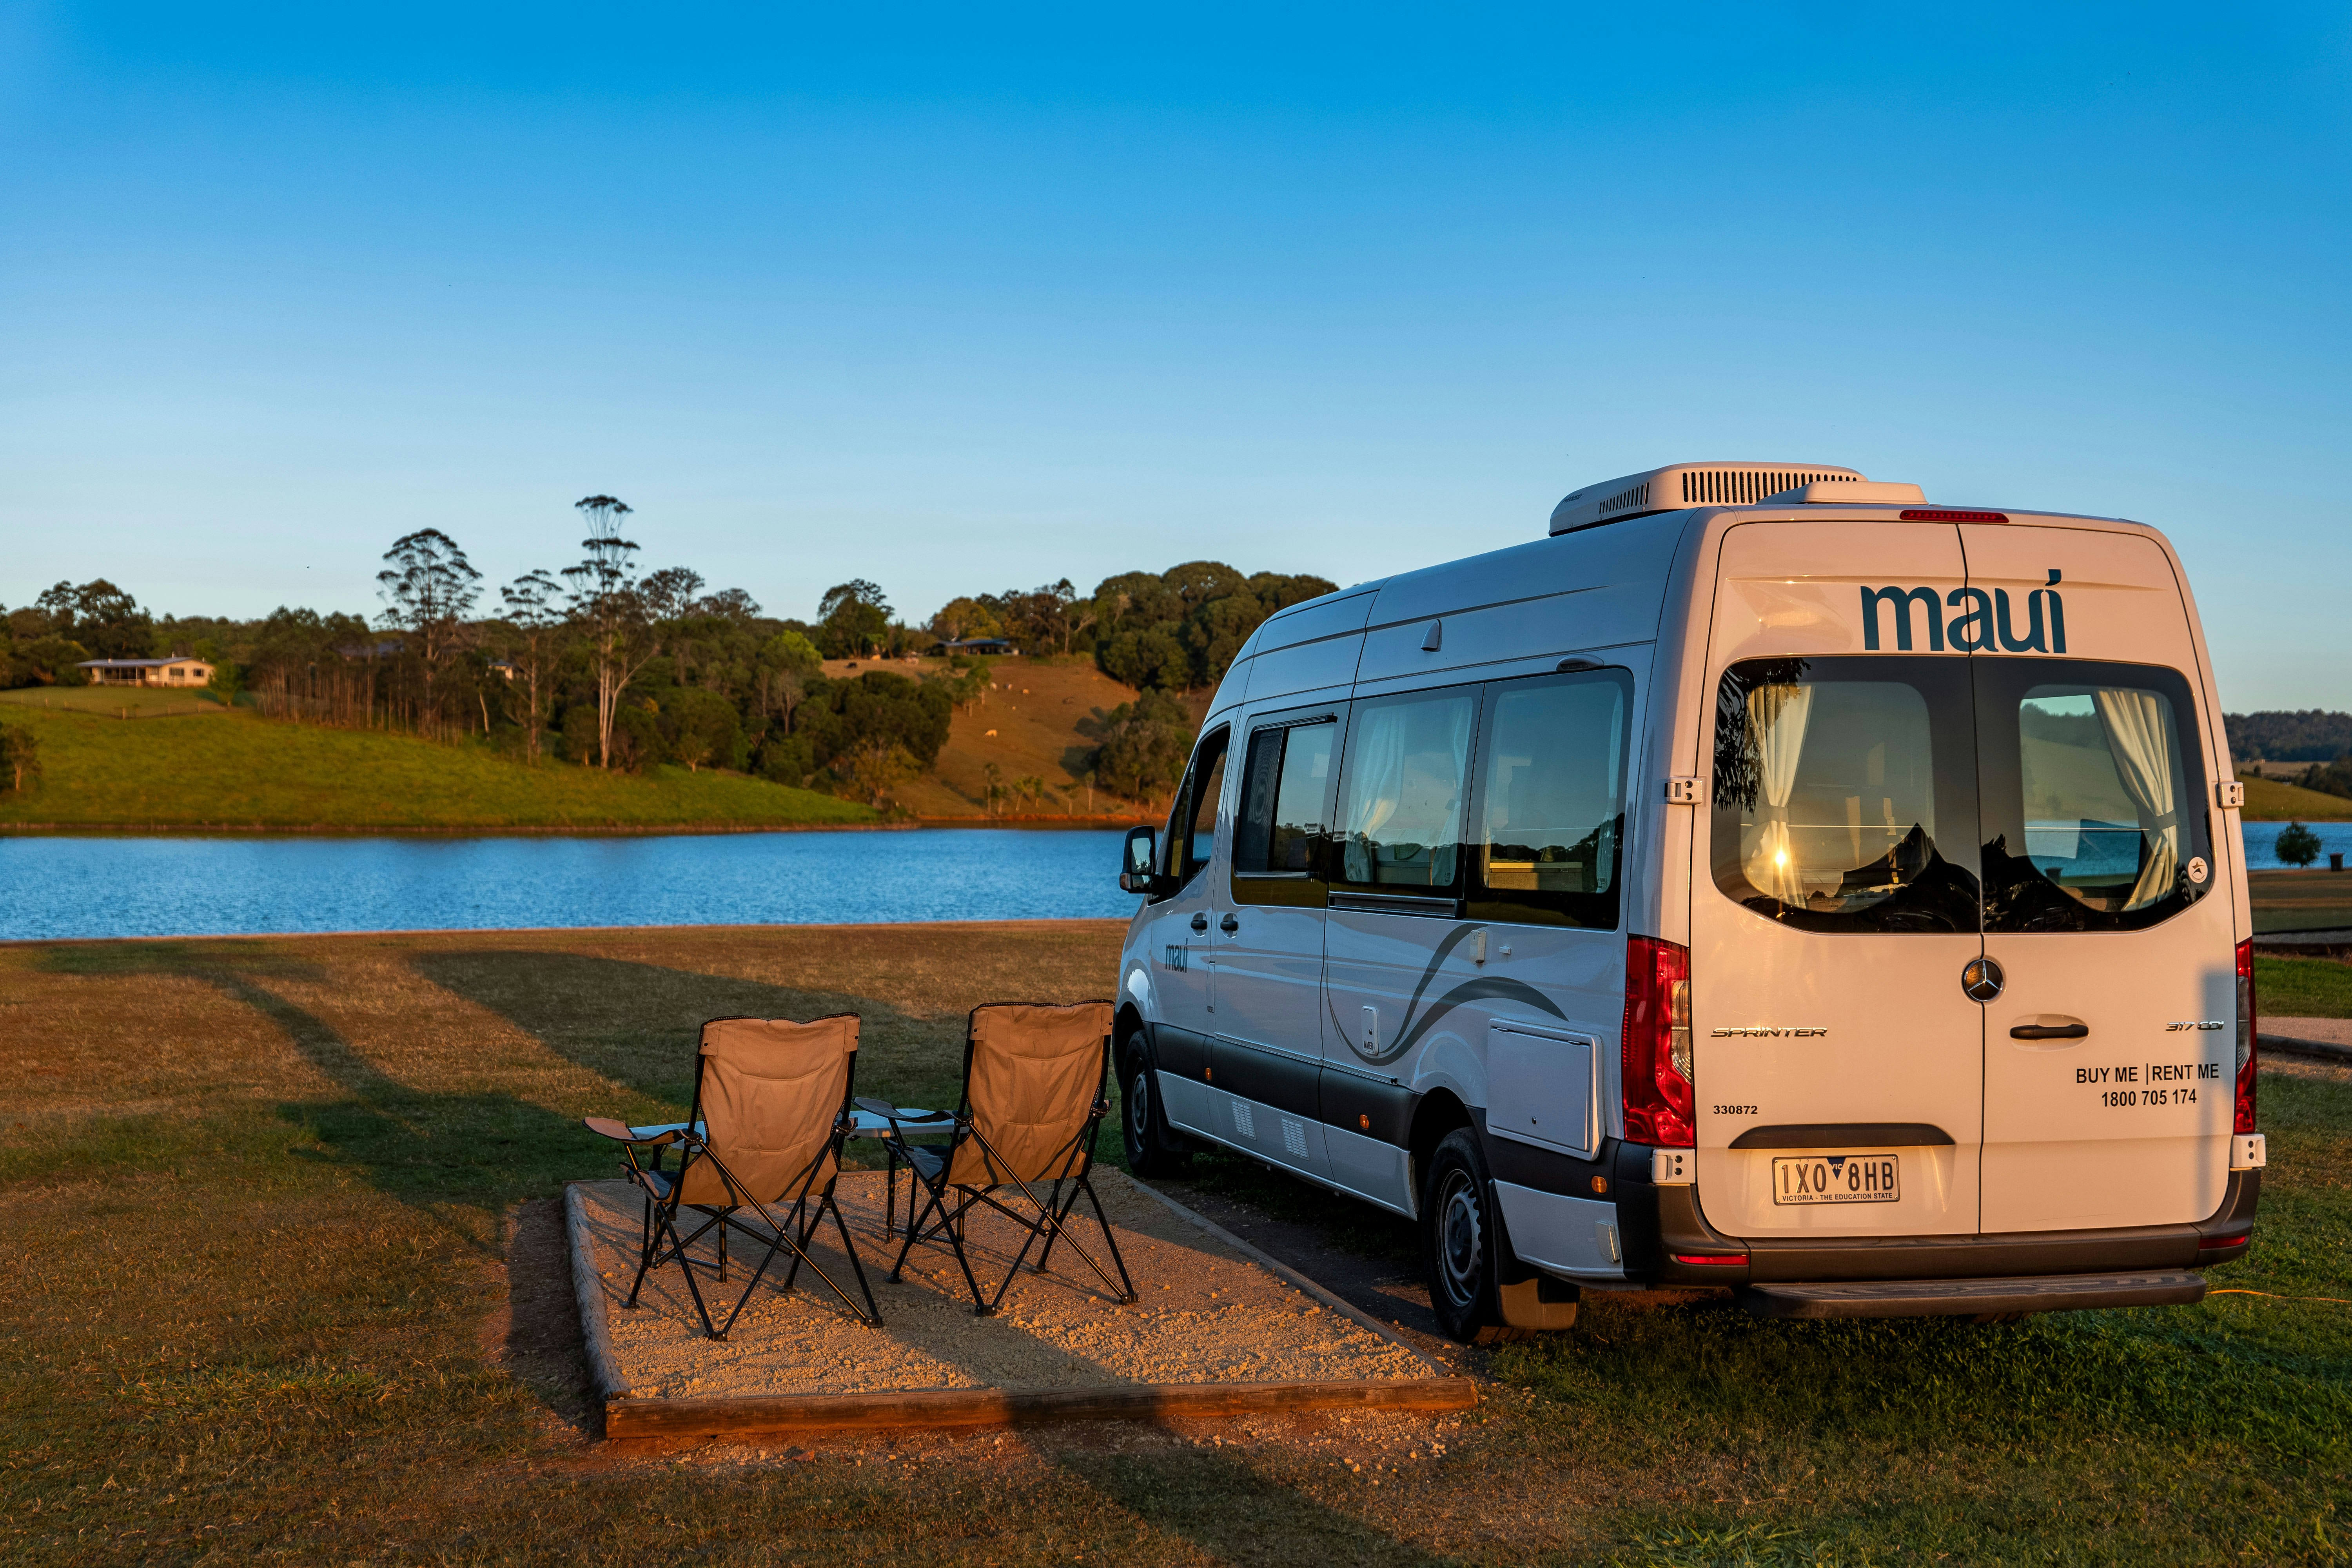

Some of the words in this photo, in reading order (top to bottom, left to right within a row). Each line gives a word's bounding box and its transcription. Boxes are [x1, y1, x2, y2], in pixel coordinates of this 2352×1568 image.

[2166, 1022, 2195, 1031] 317
[2197, 1021, 2224, 1030] CDI
[1710, 1027, 1828, 1038] SPRINTER
[1364, 1040, 1373, 1050] WATER
[2076, 1068, 2110, 1083] BUY
[2115, 1067, 2138, 1082] ME
[2198, 1063, 2219, 1079] ME
[2102, 1091, 2136, 1107] 1800
[2141, 1090, 2167, 1105] 705
[2172, 1089, 2197, 1104] 174
[1713, 1105, 1758, 1114] 330872
[1848, 1161, 1894, 1192] 8HB
